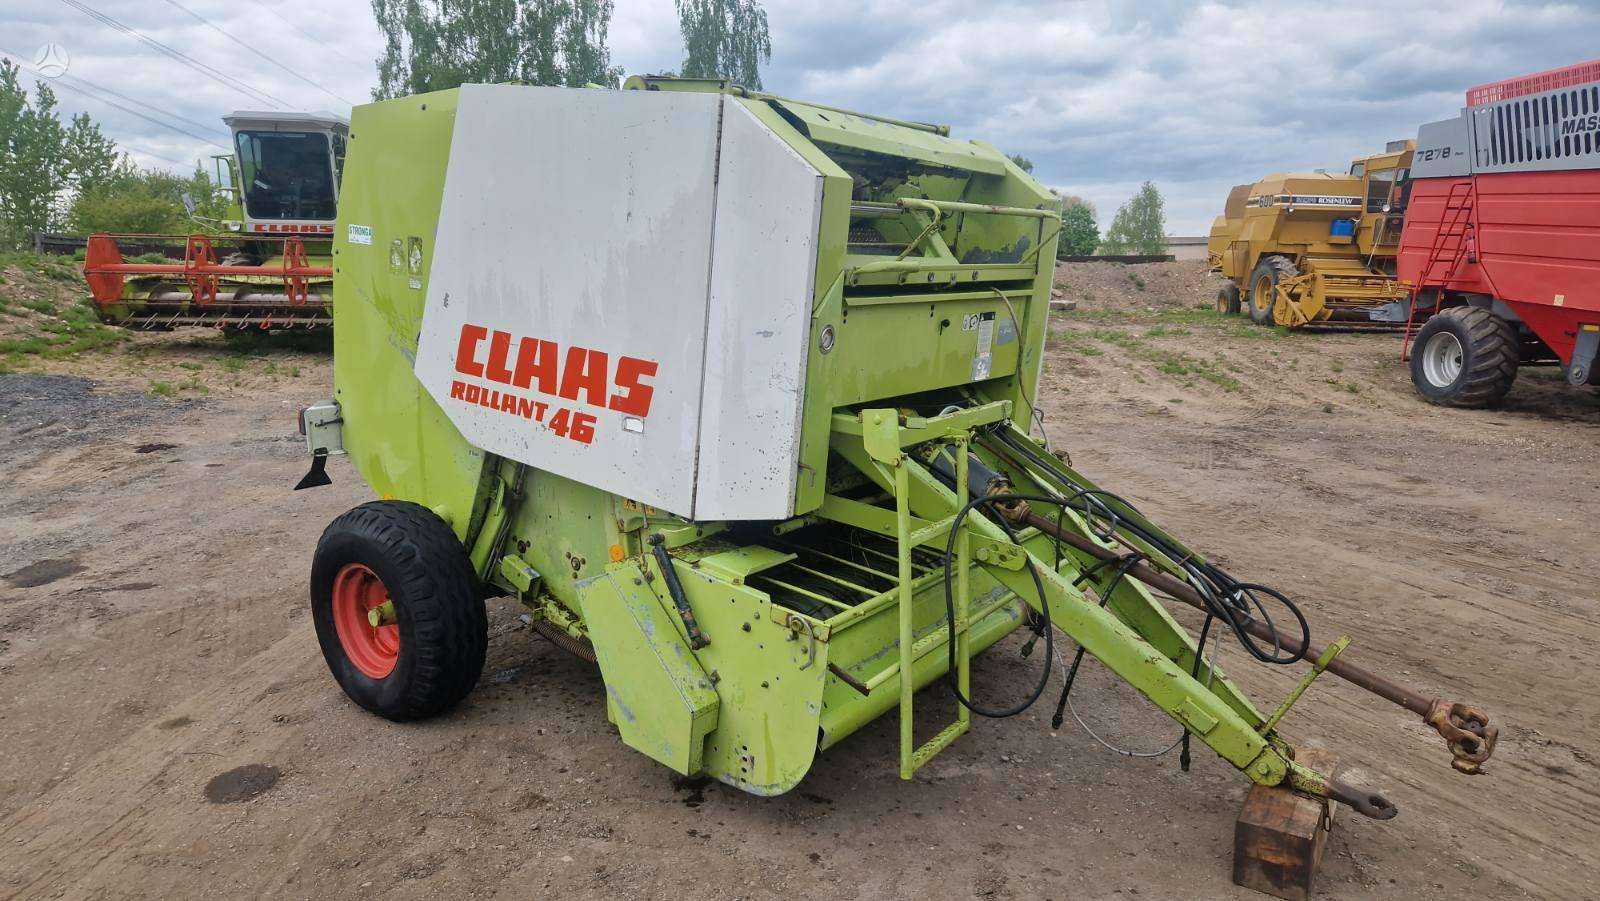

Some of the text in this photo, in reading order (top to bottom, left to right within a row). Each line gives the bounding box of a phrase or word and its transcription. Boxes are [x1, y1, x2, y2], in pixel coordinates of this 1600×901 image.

[1416, 147, 1451, 161] 7278
[255, 224, 333, 233] CLAAS
[455, 323, 658, 417] CLAAS
[450, 380, 597, 445] ROLLANT 46
